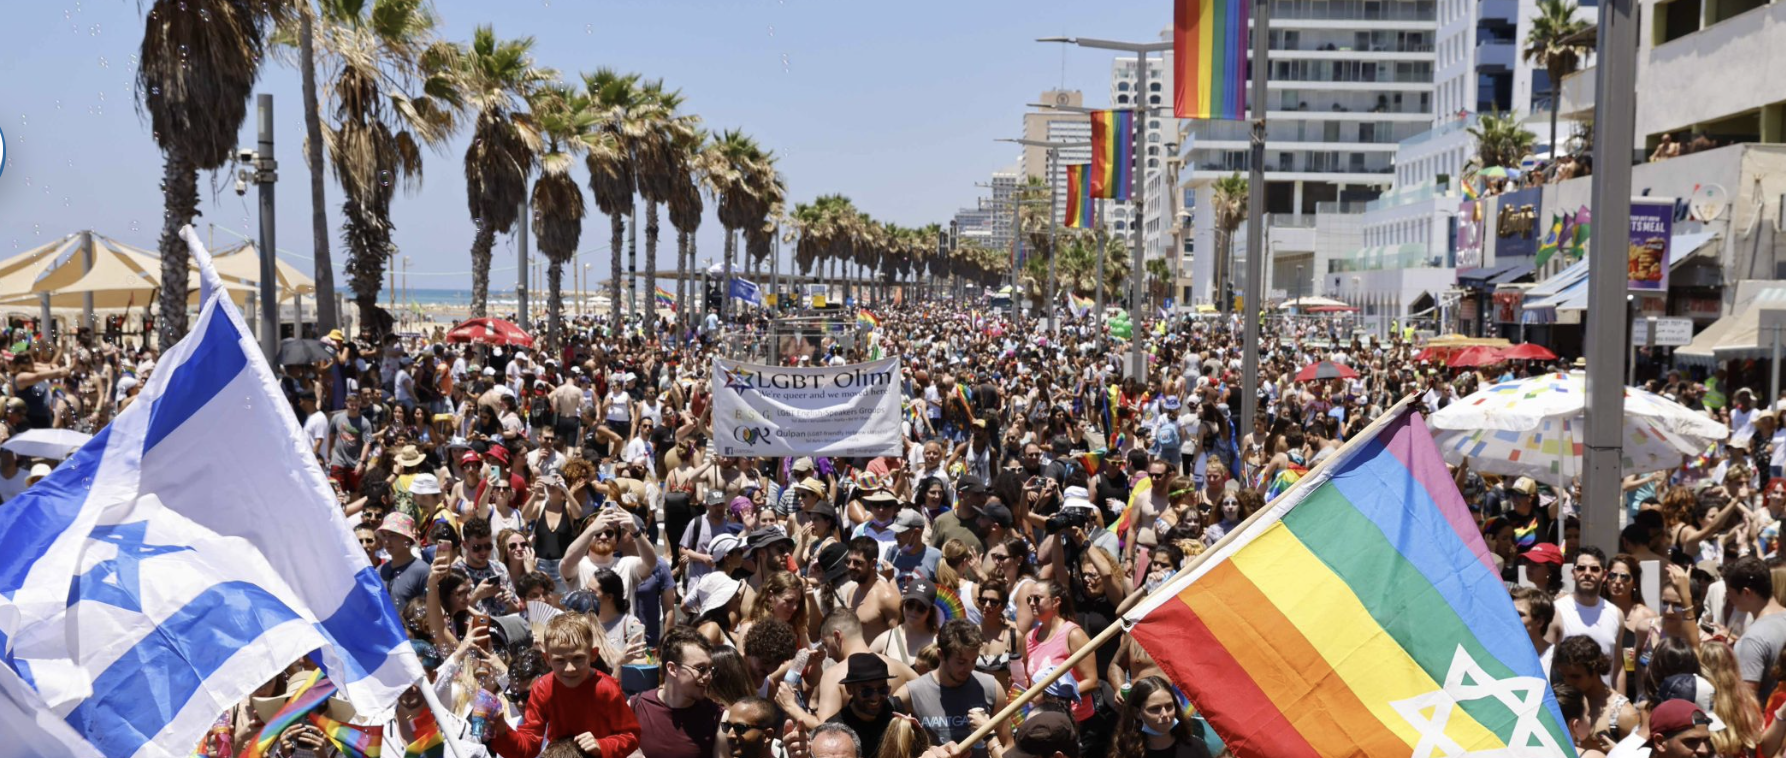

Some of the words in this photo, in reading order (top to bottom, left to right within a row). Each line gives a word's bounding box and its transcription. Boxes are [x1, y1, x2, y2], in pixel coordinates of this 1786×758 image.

[1642, 222, 1666, 233] MEAL
[757, 371, 824, 389] LGBT
[834, 368, 891, 389] Olim
[759, 389, 781, 398] We're
[783, 391, 808, 401] queer
[809, 390, 825, 399] and
[827, 391, 840, 399] we
[841, 390, 868, 398] moved
[870, 388, 891, 396] here!
[735, 409, 742, 419] E
[777, 409, 795, 417] LGBT
[859, 406, 885, 416] Groups
[921, 716, 970, 727] AVANTGA
